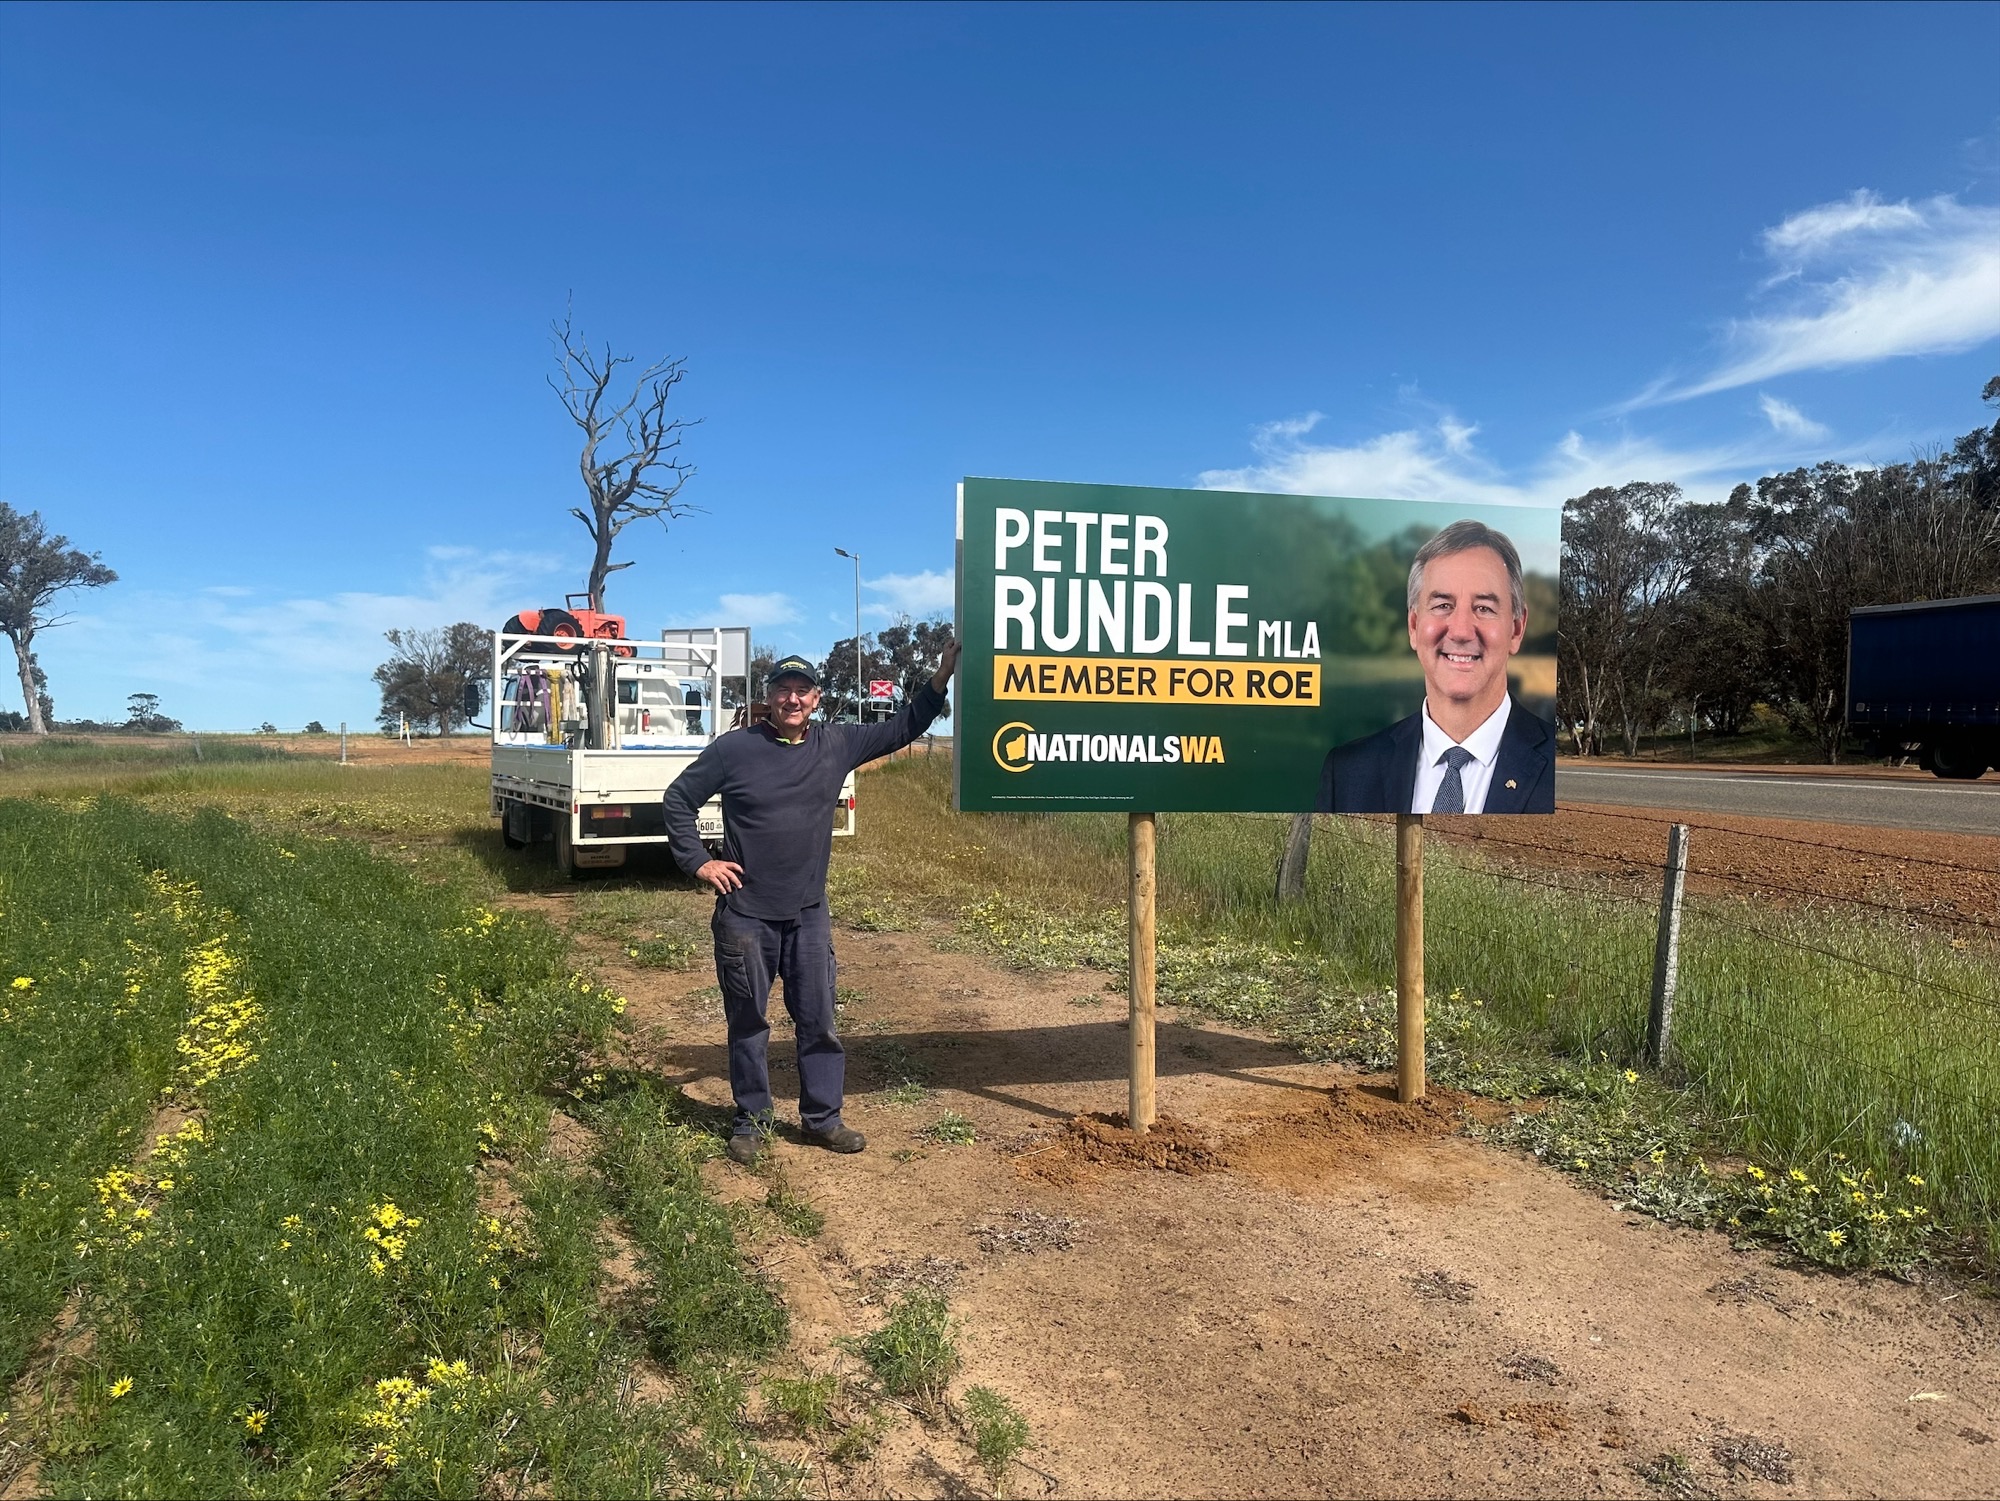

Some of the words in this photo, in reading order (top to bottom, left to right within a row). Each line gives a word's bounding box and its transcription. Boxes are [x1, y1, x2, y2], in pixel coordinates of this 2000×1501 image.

[995, 507, 1169, 577] PETER
[993, 575, 1249, 656] RUNDLE
[1257, 619, 1321, 658] MLA
[1003, 663, 1157, 696] MEMBER
[1169, 667, 1234, 698] FOR
[1246, 669, 1313, 699] ROE
